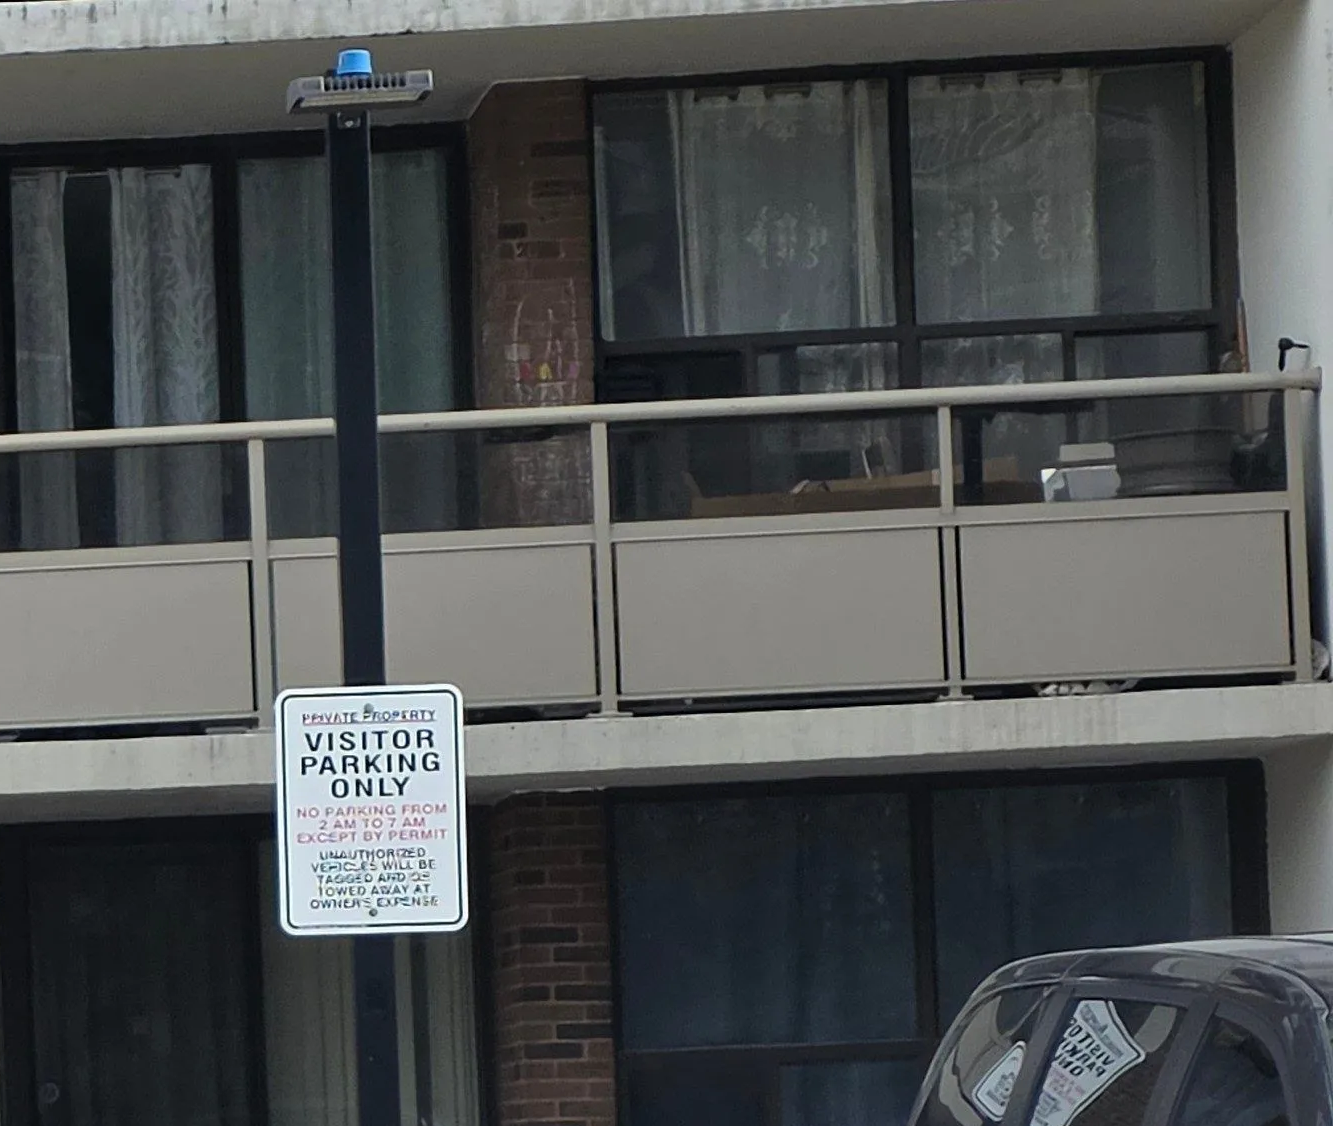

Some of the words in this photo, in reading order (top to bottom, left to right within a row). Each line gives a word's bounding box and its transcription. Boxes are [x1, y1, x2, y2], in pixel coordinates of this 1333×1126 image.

[302, 712, 357, 725] PRIVATE
[363, 710, 435, 722] PROPERTY
[305, 729, 434, 751] VISITOR
[301, 752, 440, 775] PARKING
[332, 777, 409, 798] ONLY
[297, 807, 319, 818] NO
[325, 804, 396, 817] PARKING
[402, 803, 447, 815] FROM
[319, 820, 328, 830] 2
[334, 819, 356, 829] AM
[362, 818, 382, 828] TO
[389, 817, 396, 827] 7
[402, 816, 426, 827] AM
[297, 832, 356, 844] EXCEPT
[364, 831, 383, 841] BY
[389, 829, 447, 841] PERMIT
[319, 847, 426, 860] UNAUTHORIZED
[311, 861, 378, 873] VEHICLES
[383, 860, 413, 871] WILL
[418, 859, 437, 870] BE
[317, 873, 373, 884] TAGGED
[318, 886, 366, 897] TOWED
[371, 885, 409, 896] AWAY
[414, 884, 431, 895] AT
[377, 895, 439, 907] EXPENSE
